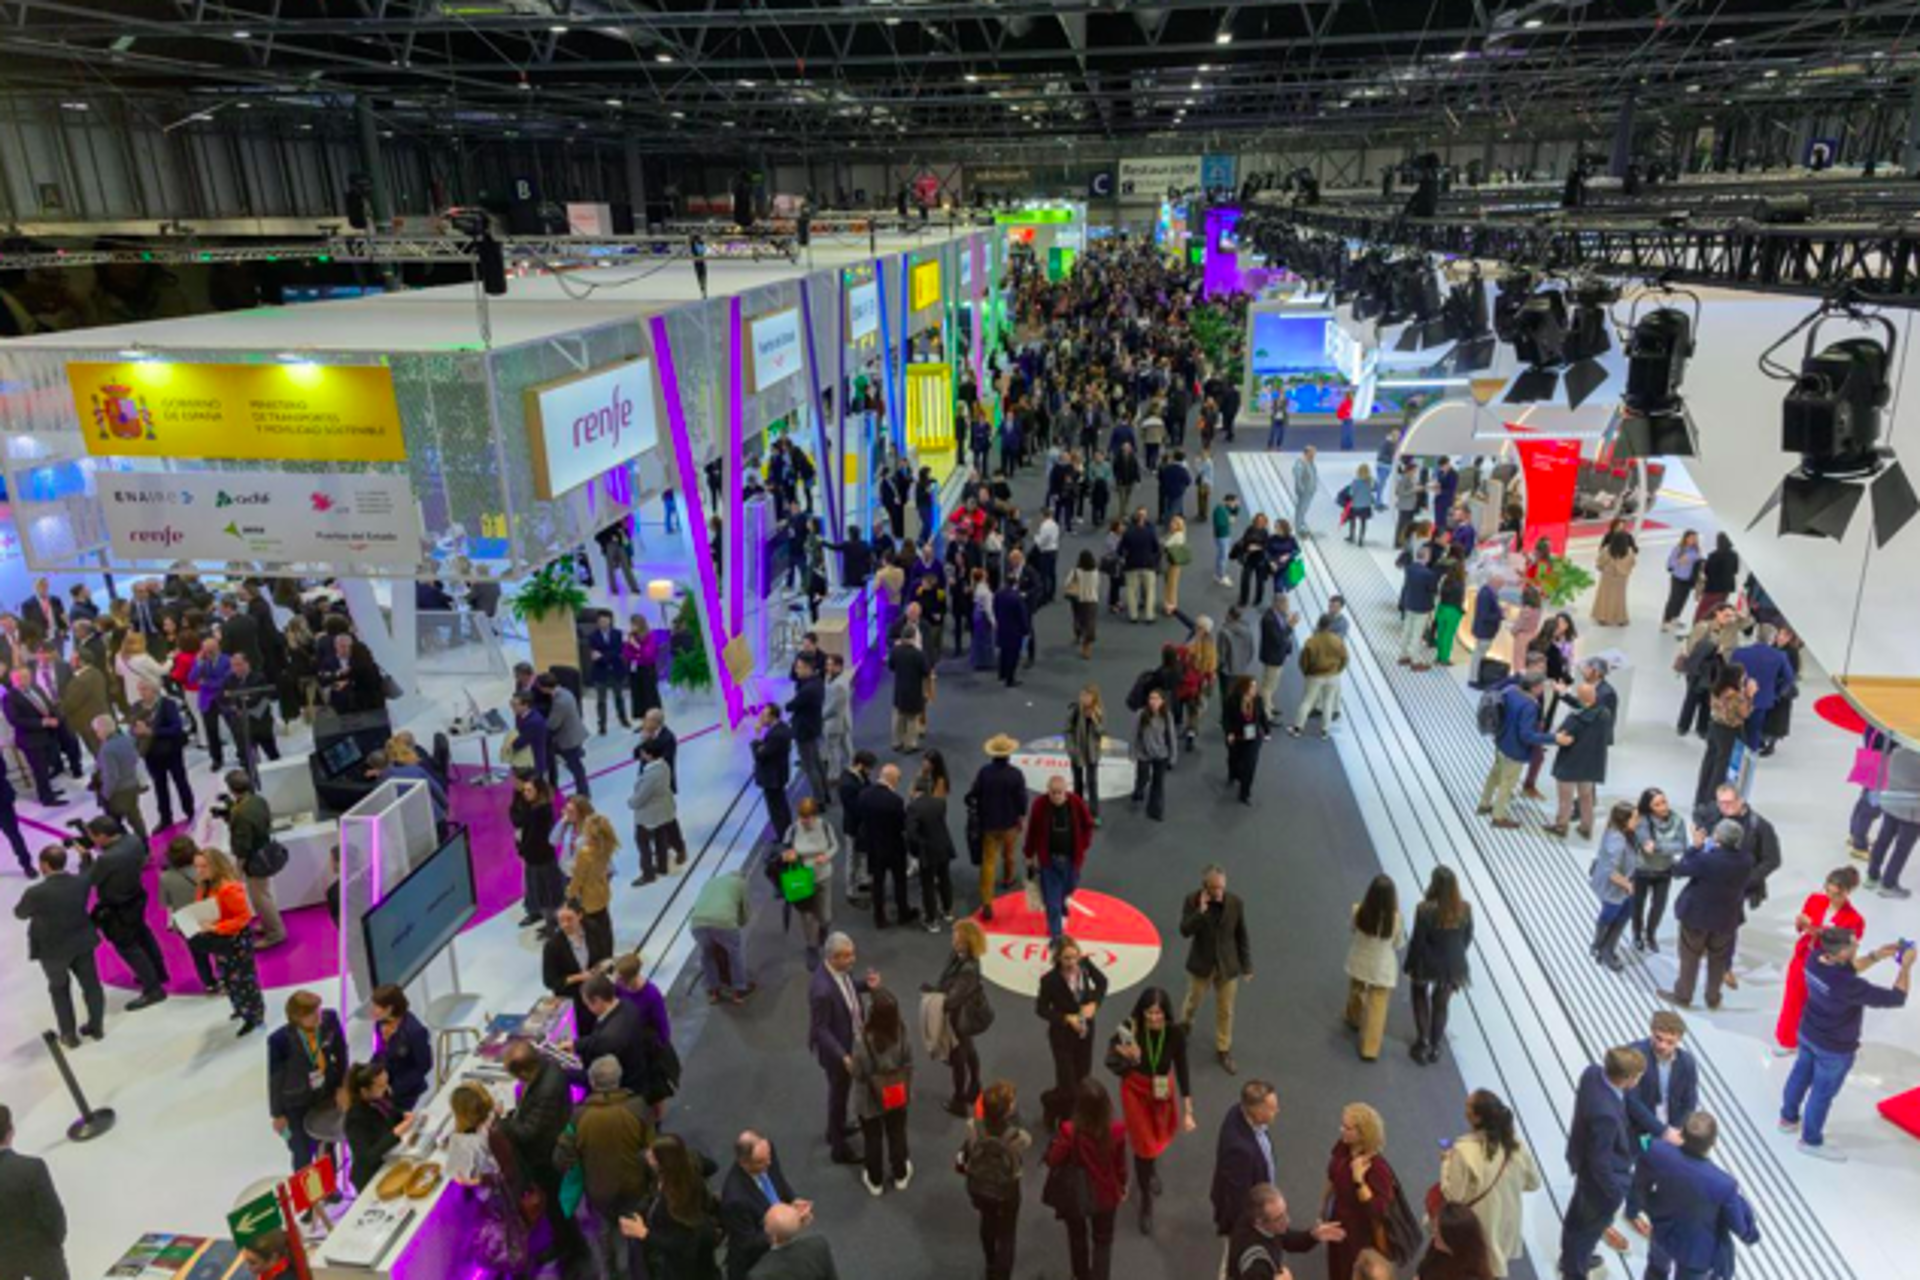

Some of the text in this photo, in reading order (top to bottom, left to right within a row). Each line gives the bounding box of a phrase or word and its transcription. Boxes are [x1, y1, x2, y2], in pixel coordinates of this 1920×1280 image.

[517, 180, 531, 199] B
[1093, 173, 1108, 194] C
[573, 384, 633, 449] renfe
[129, 525, 184, 547] renfe
